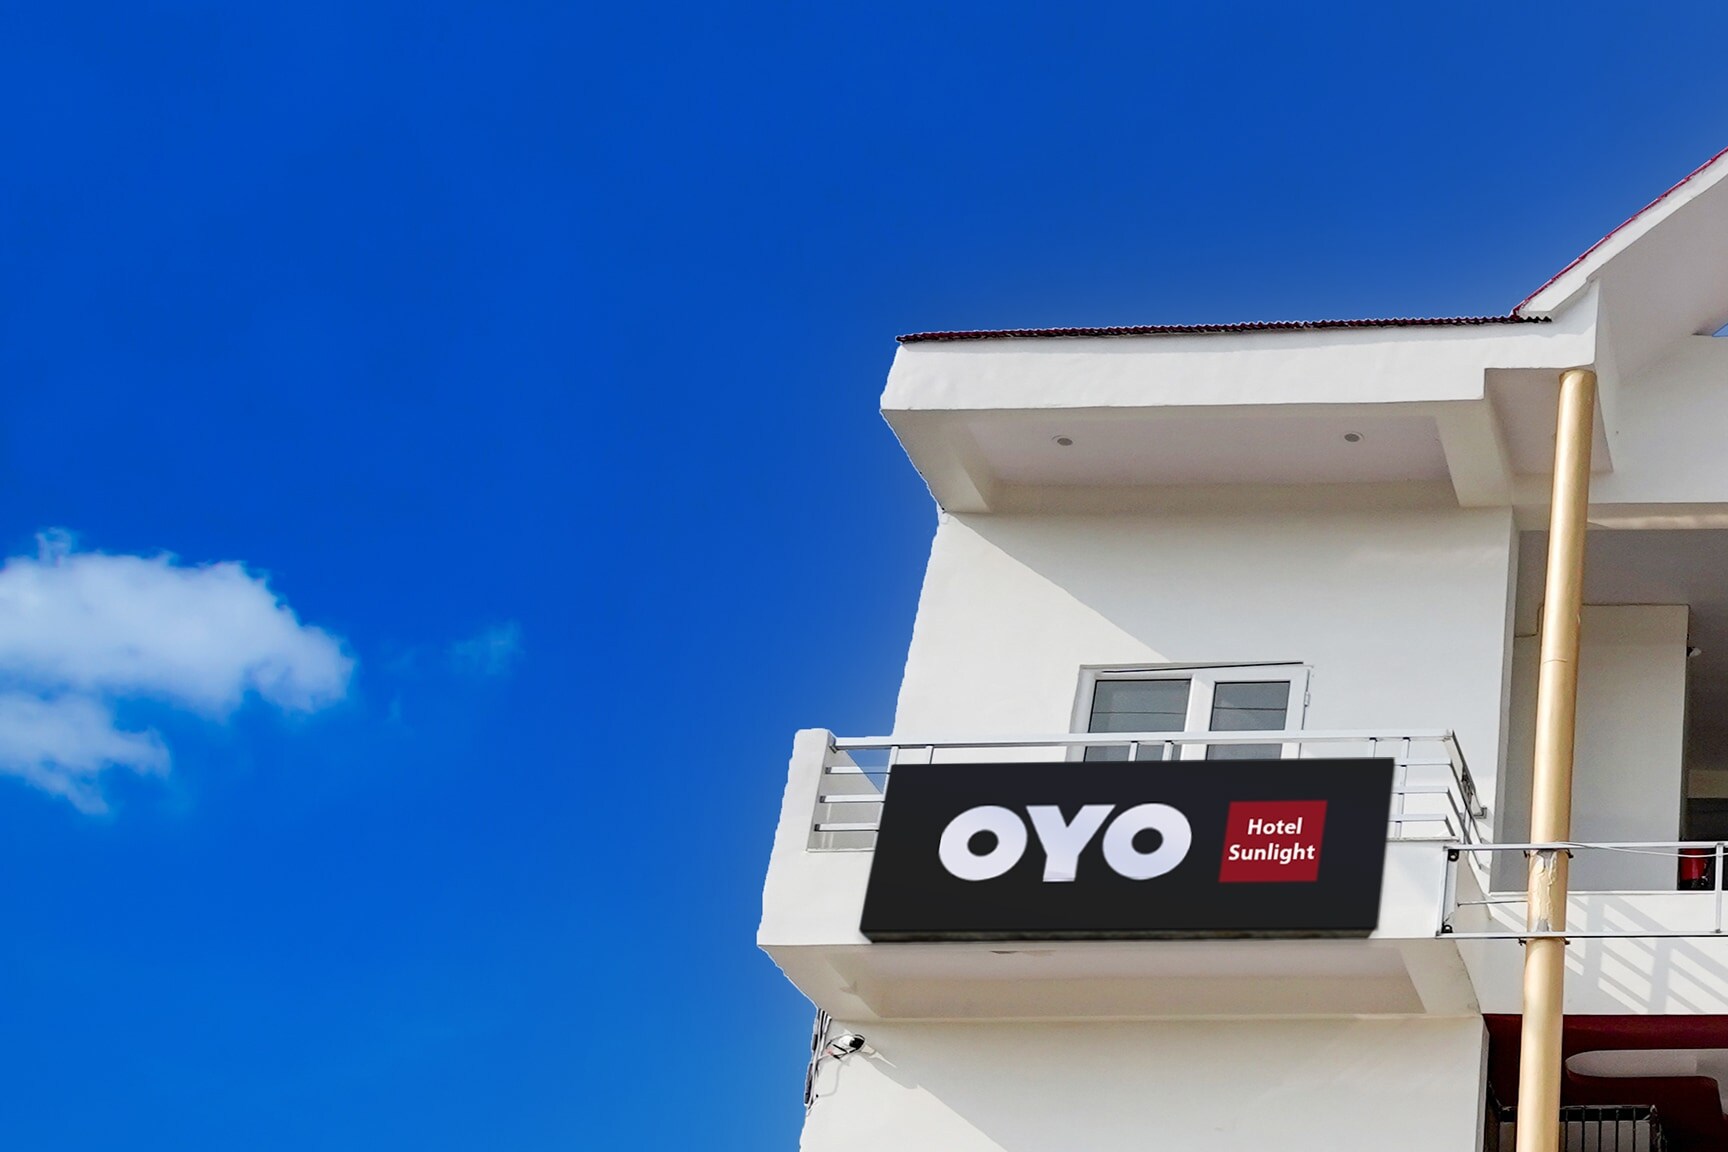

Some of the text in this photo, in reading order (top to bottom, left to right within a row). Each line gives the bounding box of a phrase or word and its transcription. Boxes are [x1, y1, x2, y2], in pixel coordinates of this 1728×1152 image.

[1247, 817, 1303, 836] Hotel
[938, 803, 1192, 882] OYO
[1228, 842, 1316, 864] Sunlight
